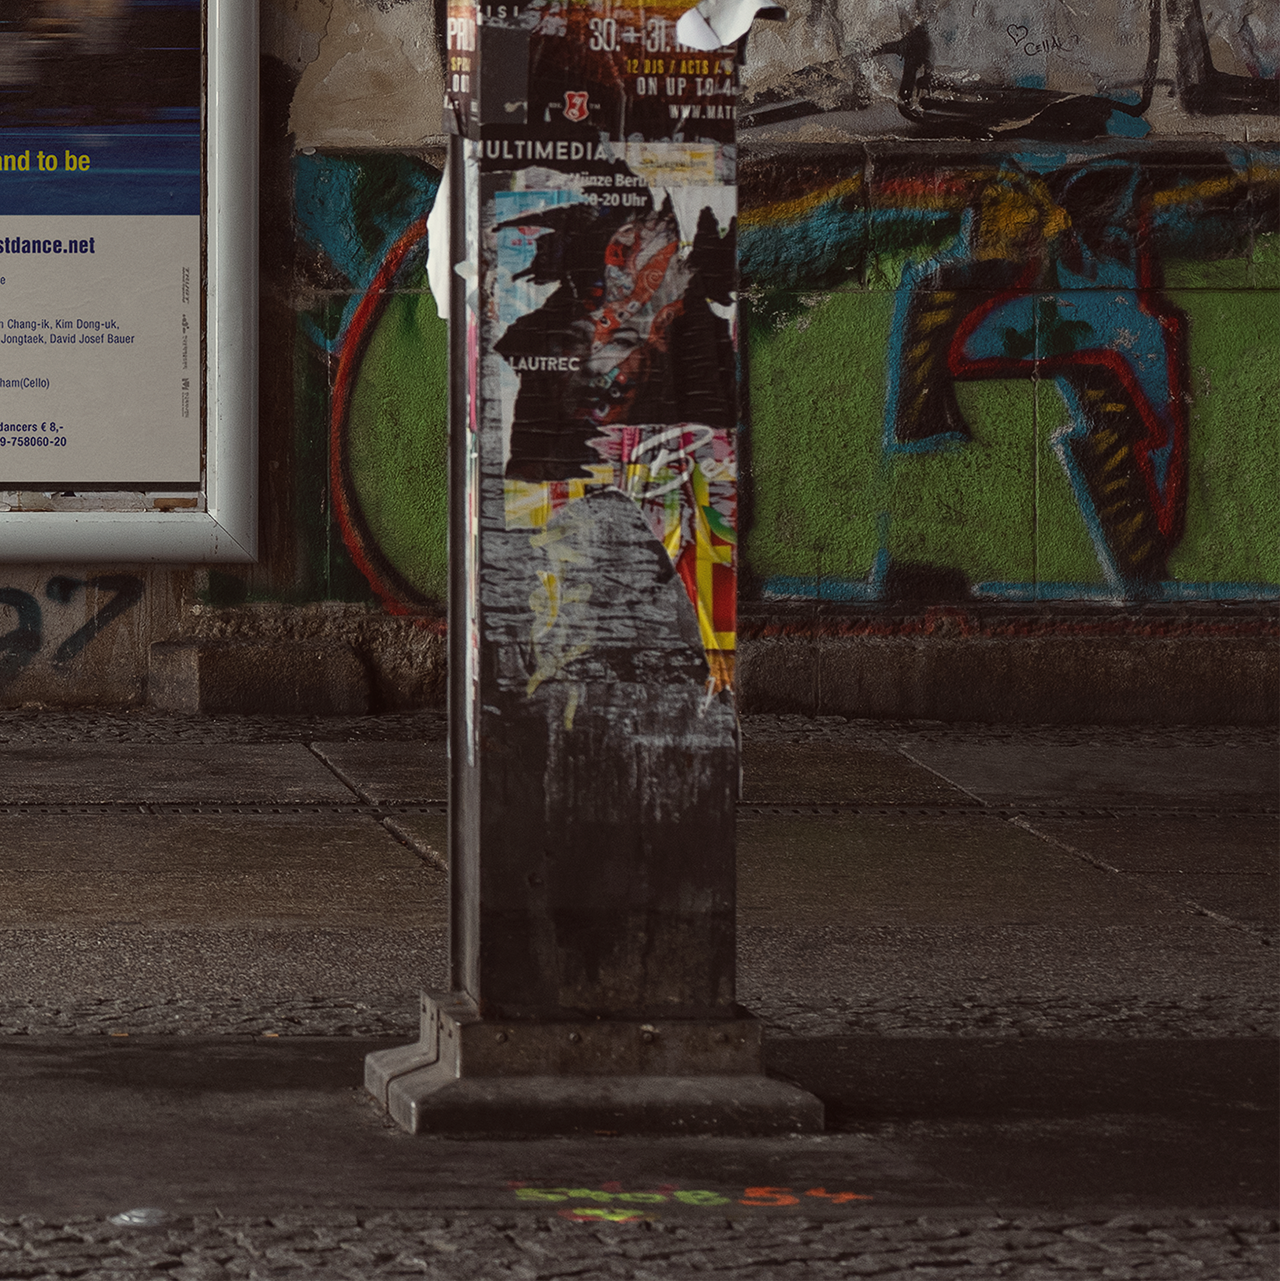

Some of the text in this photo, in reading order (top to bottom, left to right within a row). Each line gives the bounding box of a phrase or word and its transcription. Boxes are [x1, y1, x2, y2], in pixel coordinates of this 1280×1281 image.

[680, 60, 709, 75] ACTS
[665, 77, 687, 96] UP
[37, 152, 58, 172] to
[64, 150, 90, 172] be
[623, 193, 648, 207] Uhr
